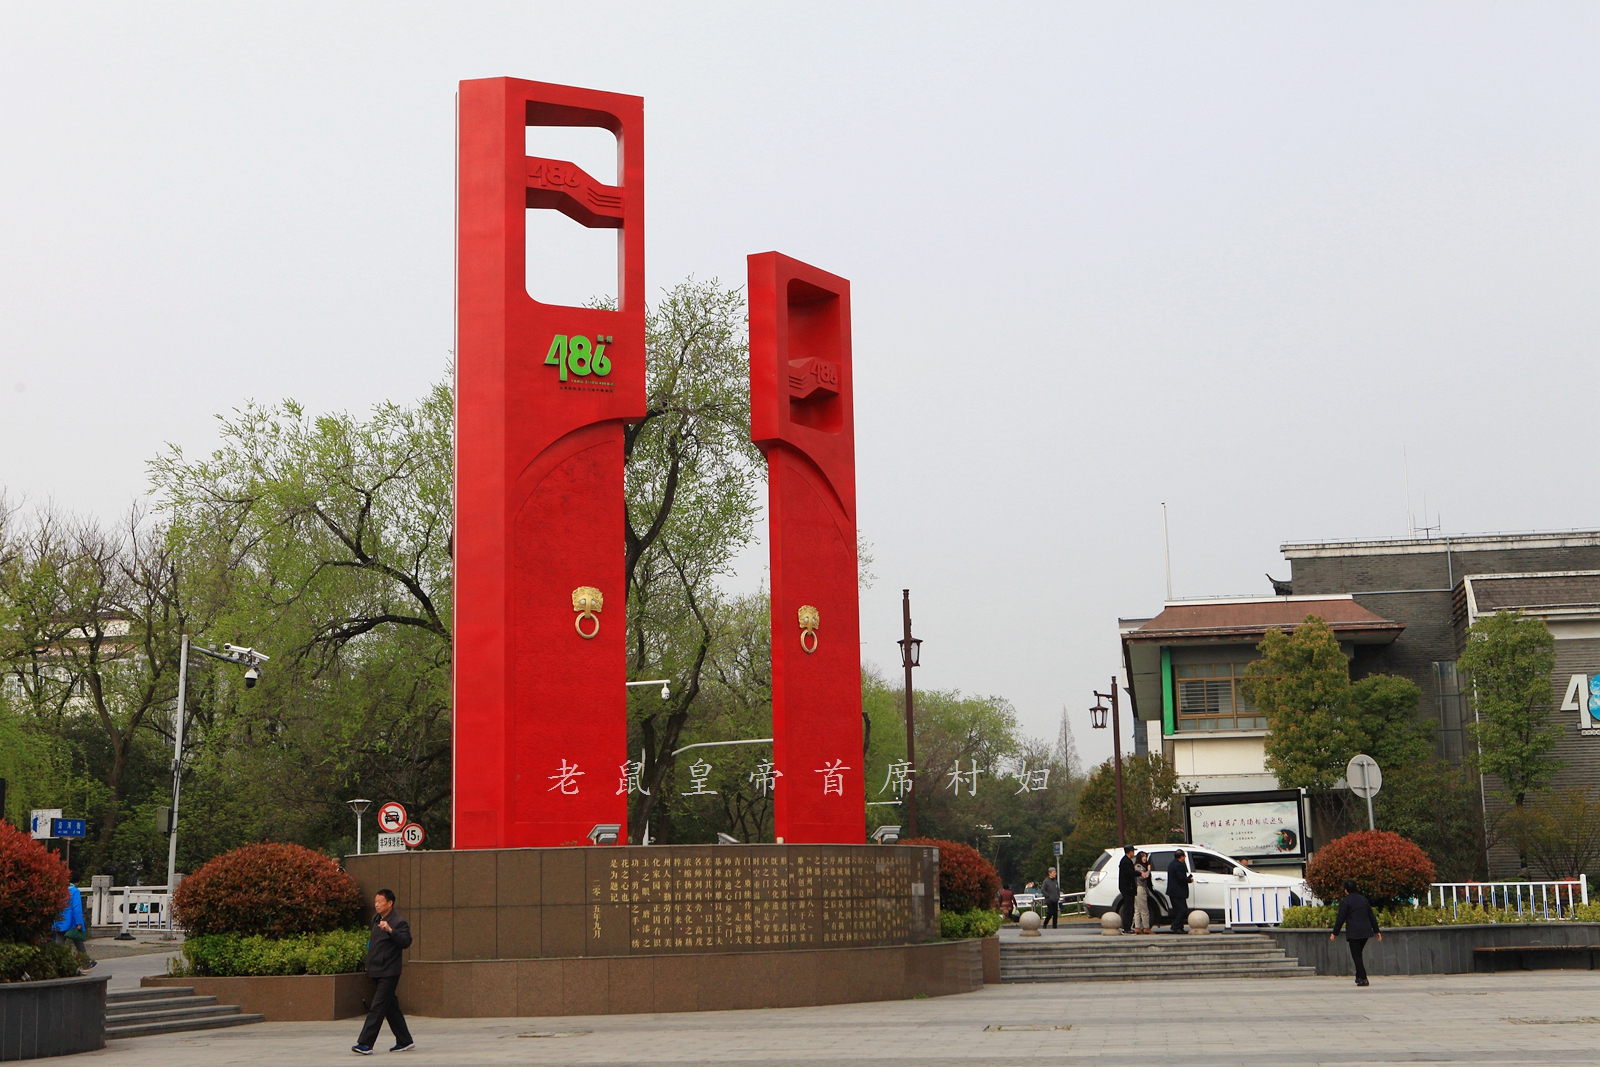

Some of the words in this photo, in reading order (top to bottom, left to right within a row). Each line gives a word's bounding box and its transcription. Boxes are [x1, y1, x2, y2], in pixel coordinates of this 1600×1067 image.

[528, 161, 581, 188] 486
[544, 334, 612, 382] 486
[810, 359, 838, 385] 486
[610, 859, 619, 909] 是为题记。
[621, 859, 630, 908] 花之心也。
[592, 879, 601, 939] 二零一五年九月
